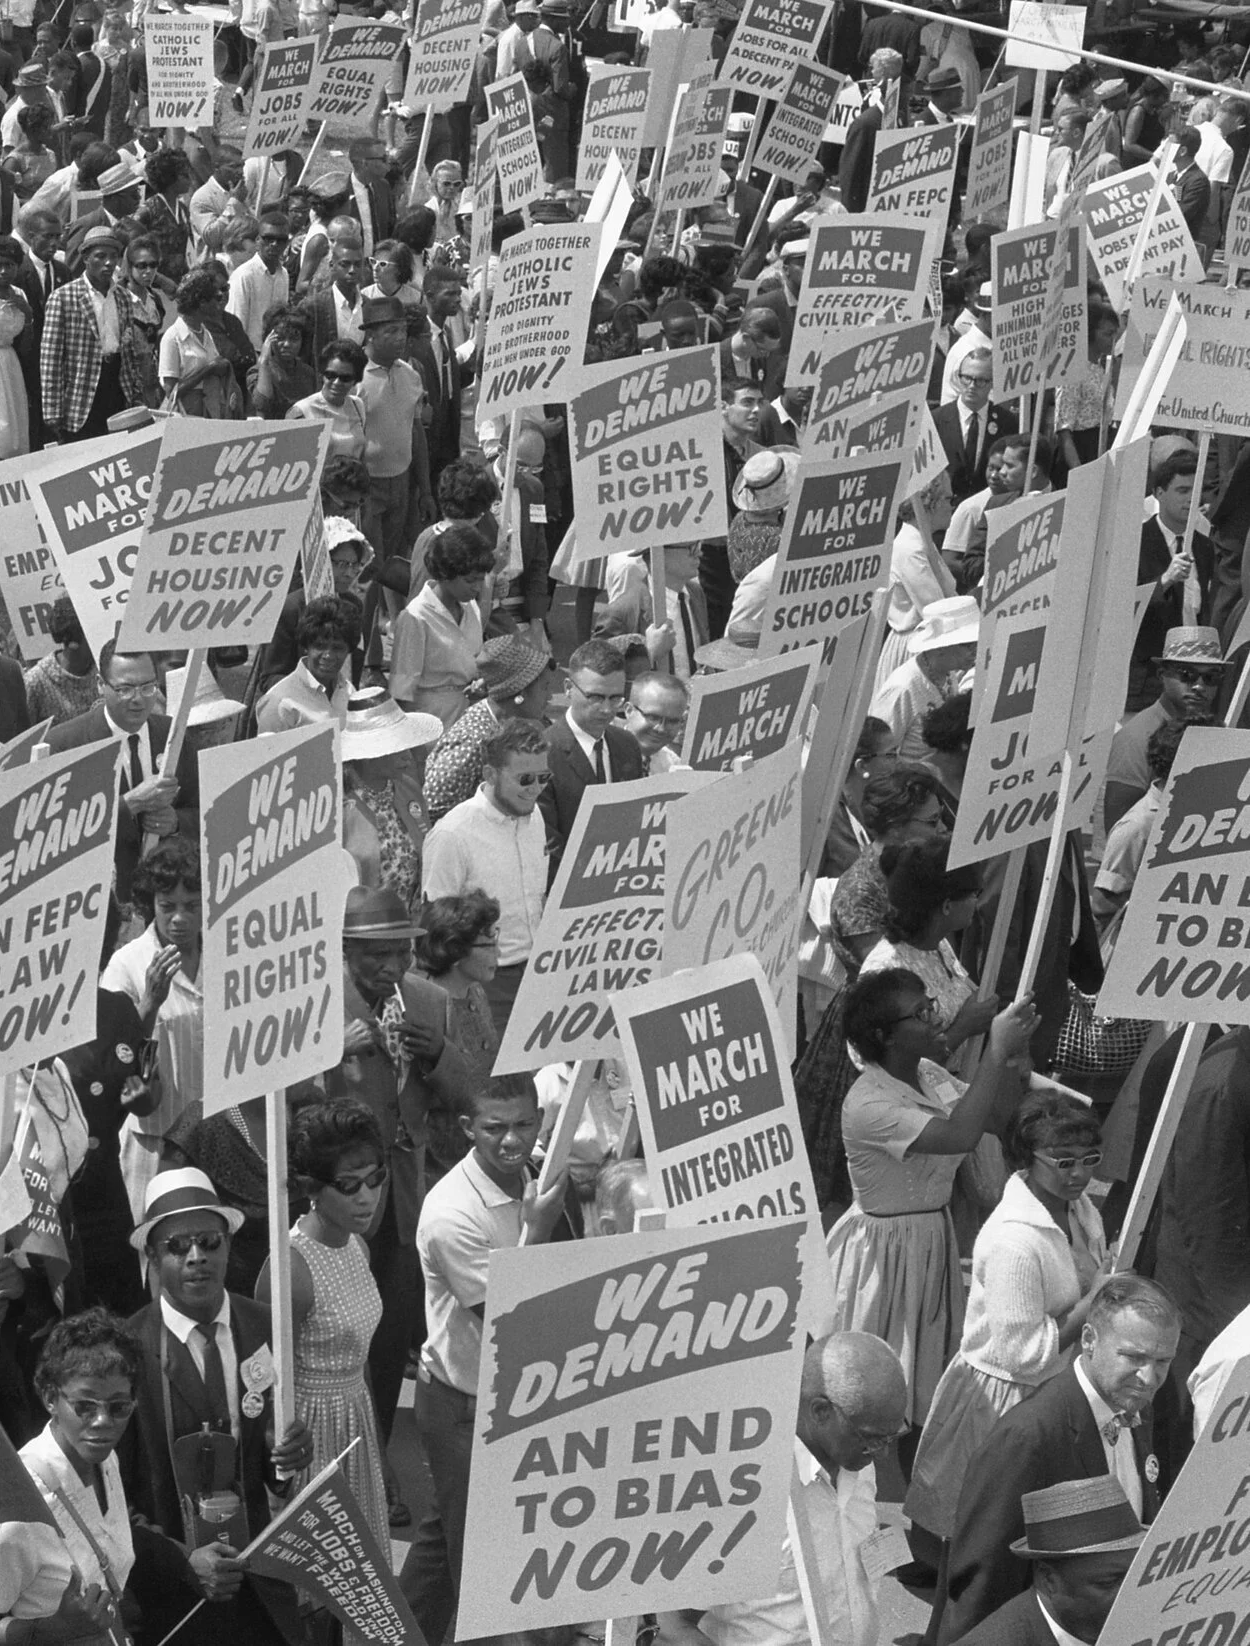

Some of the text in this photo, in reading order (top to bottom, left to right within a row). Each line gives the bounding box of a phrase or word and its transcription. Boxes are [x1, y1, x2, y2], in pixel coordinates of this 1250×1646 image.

[153, 35, 201, 45] CATHOLIC
[160, 46, 188, 55] JEWS
[330, 41, 394, 60] DEMAND
[351, 28, 379, 45] WE
[423, 38, 470, 55] DECENT
[152, 57, 203, 66] PROTESTANT
[267, 59, 309, 81] MARCH
[326, 67, 375, 86] EQUAL
[414, 58, 471, 76] HOUSING
[319, 81, 372, 100] RIGHTS
[415, 73, 466, 95] NOW!
[808, 73, 825, 89] WE
[156, 97, 206, 118] NOW!
[260, 93, 302, 114] JOBS
[310, 96, 365, 117] NOW!
[791, 85, 831, 109] MARCH
[258, 113, 297, 126] FOR ALL
[776, 107, 823, 136] INTEGRATED
[252, 126, 299, 150] NOW!
[768, 126, 815, 153] SCHOOLS
[763, 147, 807, 173] NOW!
[510, 236, 591, 261] MARCH TOGETHER
[503, 255, 572, 283] CATHOLIC
[509, 275, 551, 297] JEWS
[812, 293, 908, 309] EFFECTIVE
[494, 290, 573, 321] PROTESTANT
[517, 315, 555, 332] DIGNITY
[504, 330, 570, 350] BROTHERHOOD
[550, 346, 571, 357] GOD
[486, 356, 566, 403] NOW!
[619, 364, 669, 403] WE
[821, 351, 925, 413] DEMAND
[584, 379, 712, 448] DEMAND
[214, 437, 276, 477] WE
[599, 438, 703, 476] EQUAL
[162, 460, 311, 521] DEMAND
[598, 465, 709, 505] RIGHTS
[838, 474, 868, 498] WE
[599, 490, 714, 542] NOW!
[799, 497, 886, 537] MARCH
[169, 529, 286, 556] DECENT
[823, 533, 856, 551] FOR
[147, 564, 284, 594] HOUSING
[779, 554, 881, 596] INTEGRATED
[145, 591, 273, 633] NOW!
[772, 588, 874, 632] SCHOOLS
[13, 771, 72, 840] WE
[249, 756, 297, 824] WE
[215, 784, 333, 905] DEMAND
[672, 771, 798, 931] GREENE
[24, 883, 102, 944] FEPC
[225, 891, 323, 957] EQUAL
[224, 939, 327, 1010] RIGHTS
[224, 984, 331, 1079] NOW!
[680, 1002, 723, 1045] WE
[655, 1032, 768, 1110] MARCH
[699, 1095, 742, 1127] FOR
[24, 1167, 48, 1192] FOR
[661, 1123, 794, 1208] INTEGRATED
[594, 1252, 708, 1330] WE
[508, 1286, 789, 1418] DEMAND
[512, 1406, 772, 1482] AN END
[515, 1463, 762, 1534] TO BIAS
[316, 1489, 407, 1635] MARCH ON WASHINGTON
[510, 1510, 757, 1604] NOW!
[263, 1543, 376, 1640] WE WANT FREEDOM
[278, 1530, 391, 1644] AND LET THE WORLD KNOW
[297, 1509, 320, 1530] FOR
[312, 1529, 356, 1572] JOBS
[356, 1584, 404, 1646] FREEDOM
